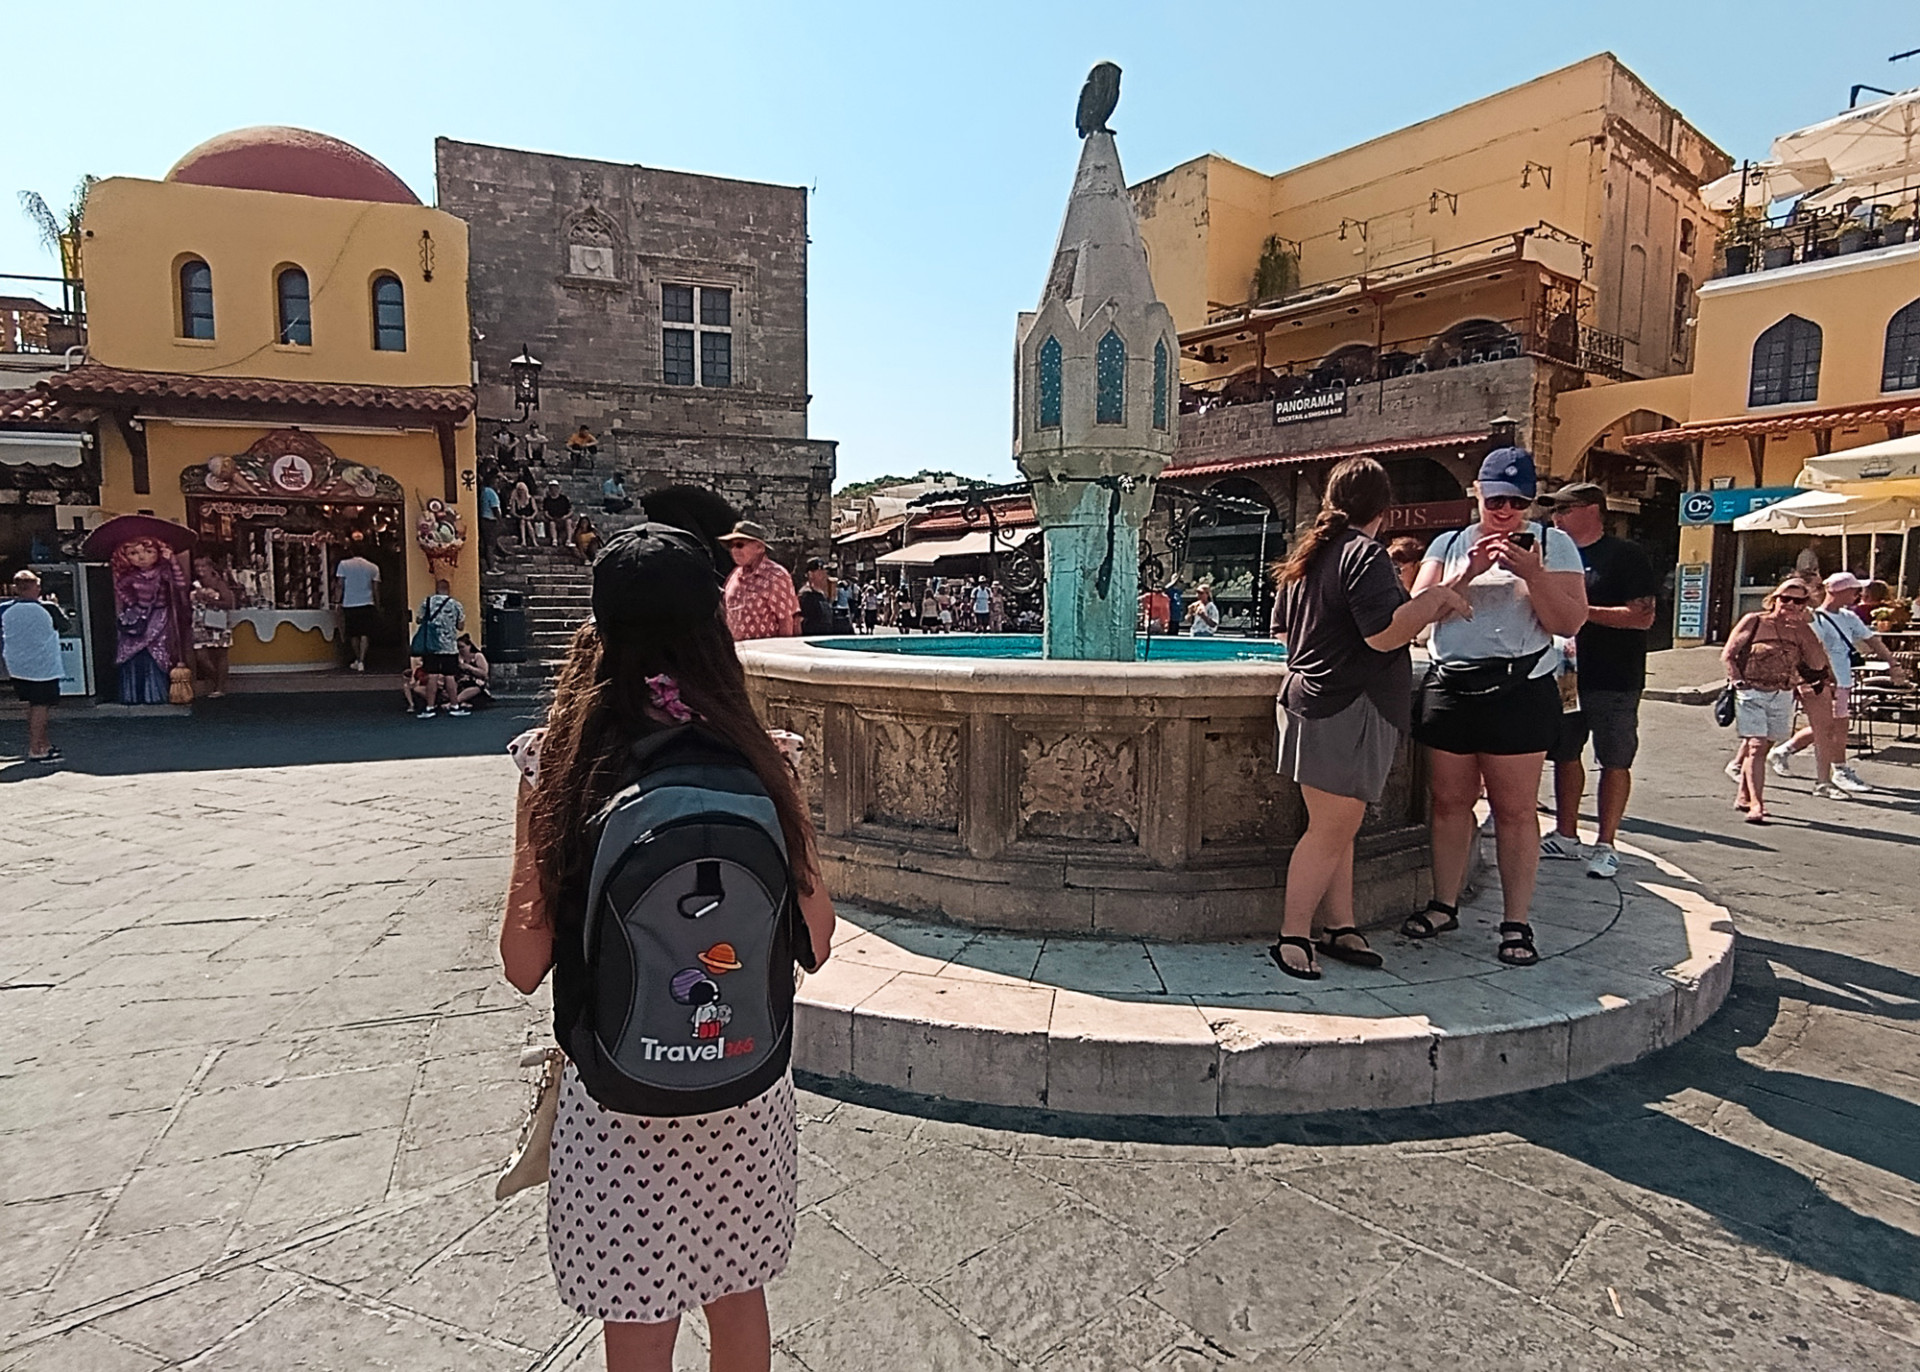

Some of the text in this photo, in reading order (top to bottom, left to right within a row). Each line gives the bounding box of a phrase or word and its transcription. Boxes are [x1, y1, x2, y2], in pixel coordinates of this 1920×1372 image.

[1276, 394, 1334, 414] PANORAMA
[1277, 414, 1303, 423] COCKTAIL
[1308, 409, 1329, 418] SHISHA
[1330, 407, 1342, 415] BAR
[1688, 499, 1712, 513] 0%
[1749, 497, 1793, 512] EX
[1389, 508, 1428, 527] PIS
[641, 1037, 725, 1062] Travel
